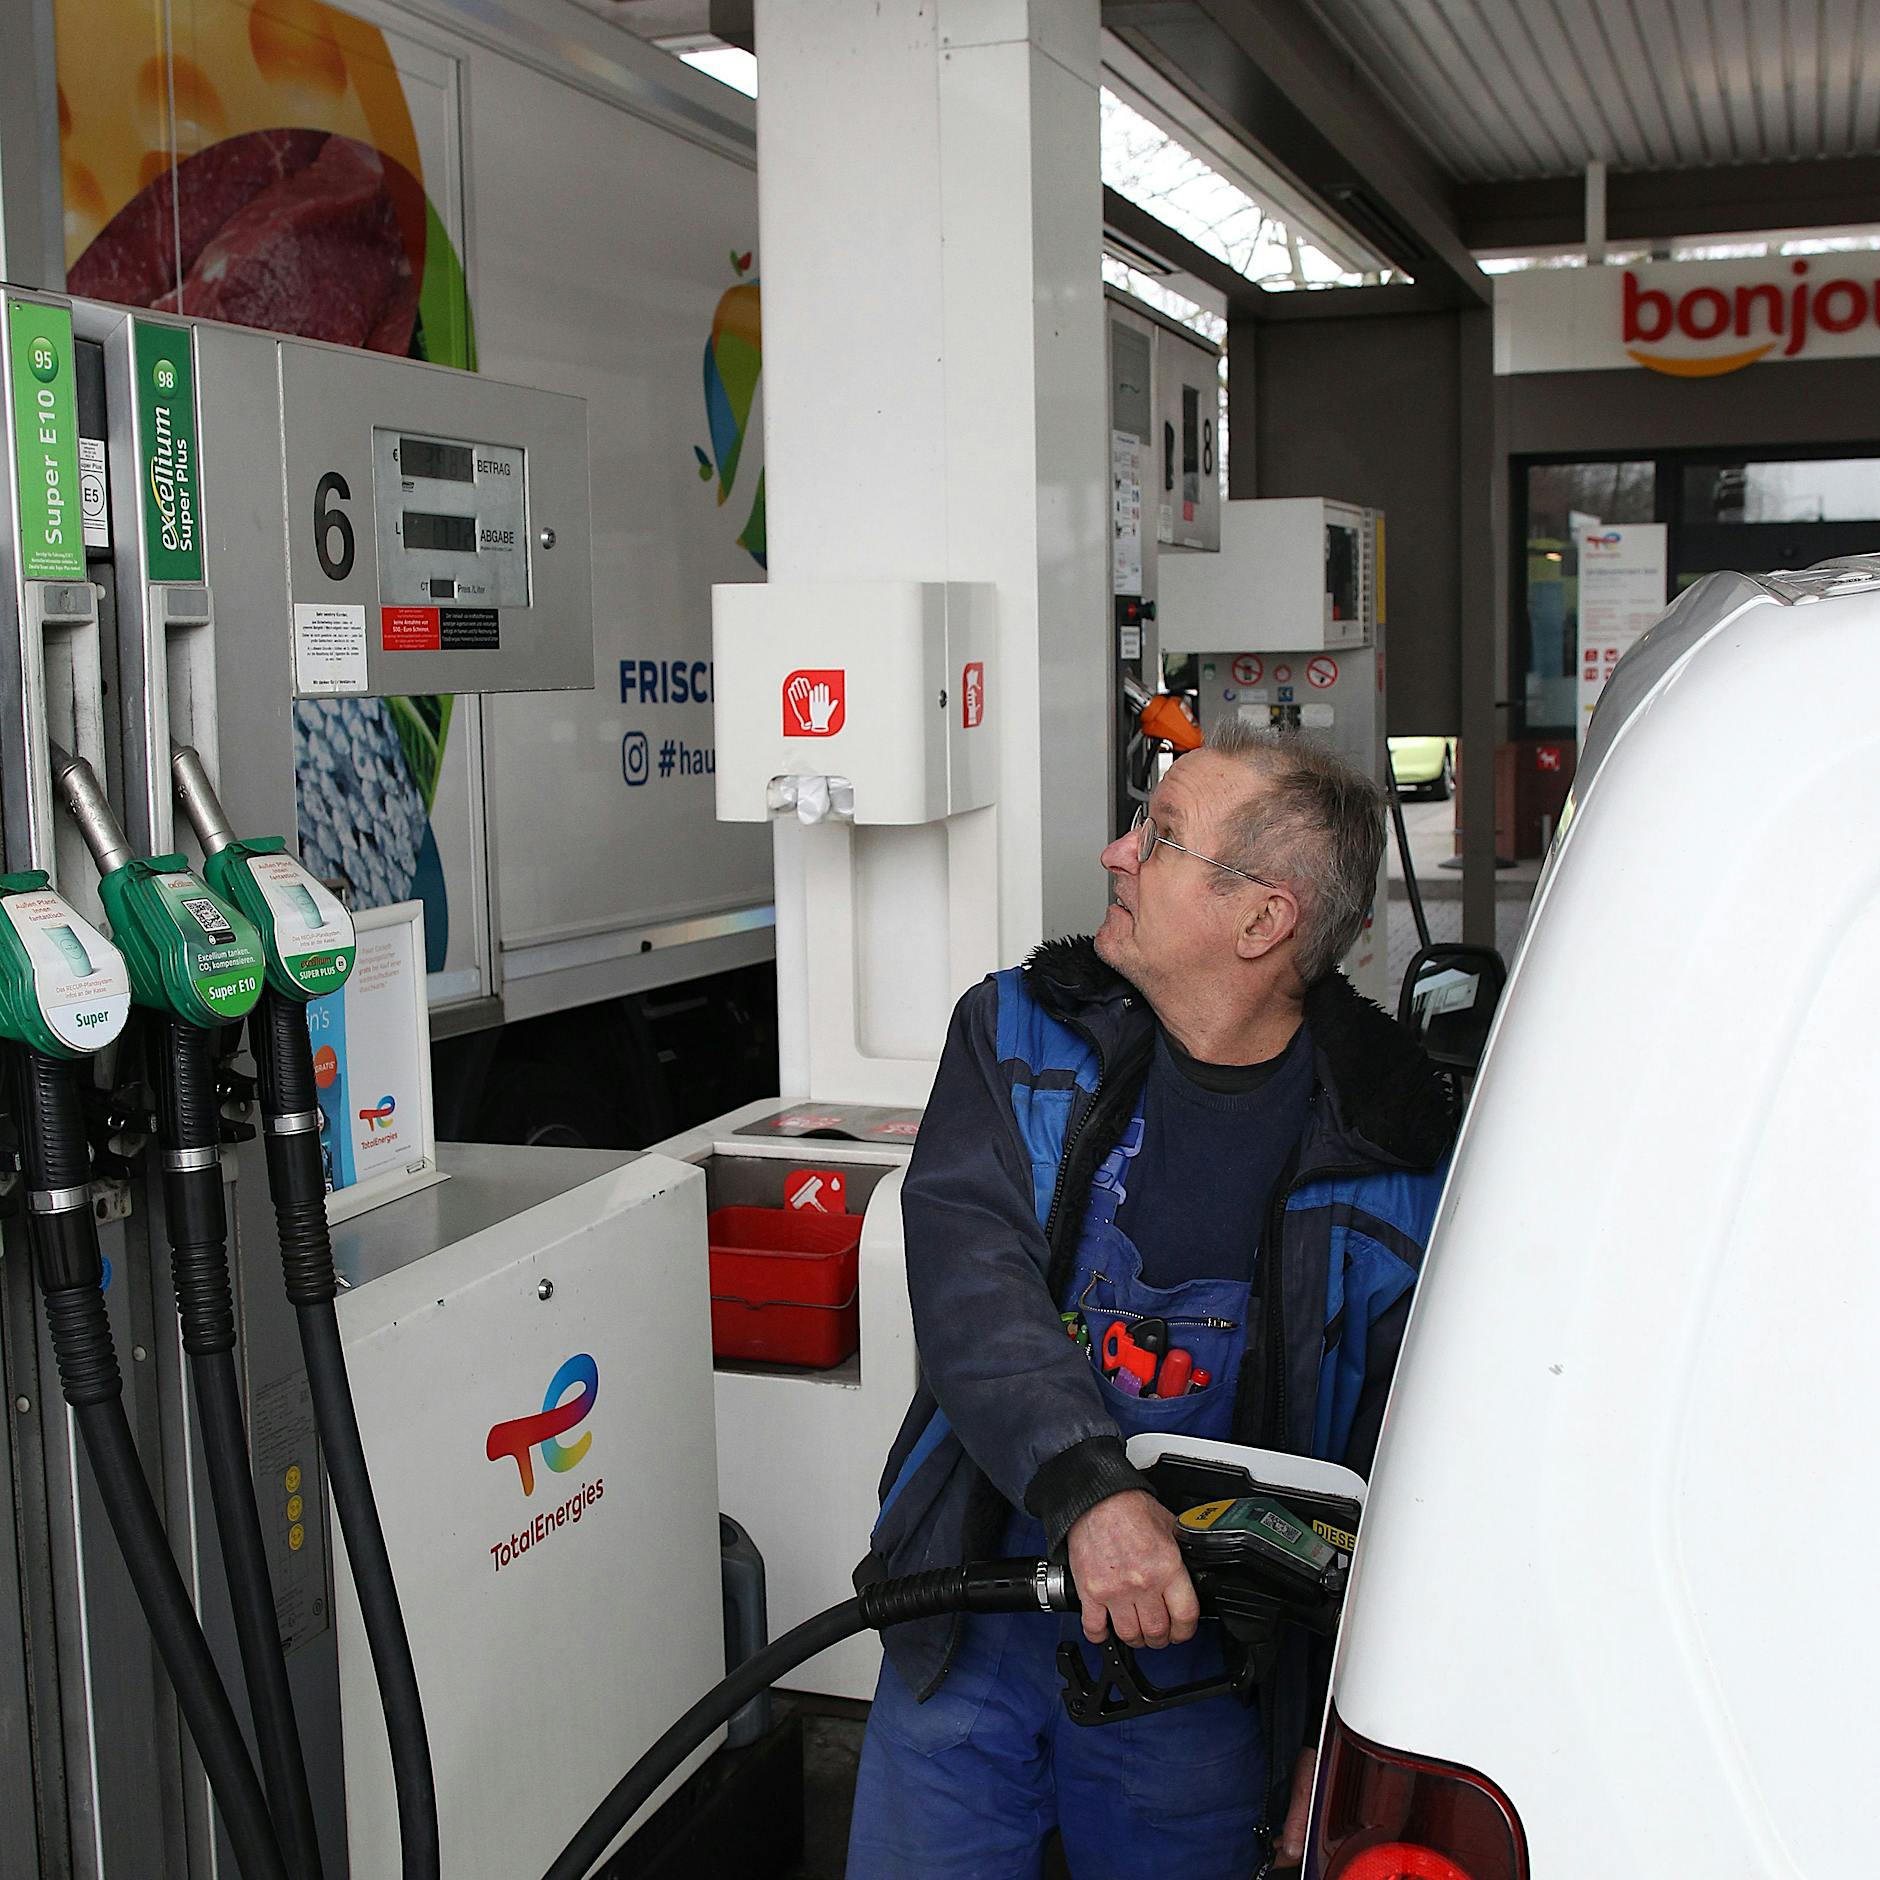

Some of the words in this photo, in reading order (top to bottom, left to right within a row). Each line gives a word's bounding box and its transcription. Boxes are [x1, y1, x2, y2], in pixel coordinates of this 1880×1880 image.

[1623, 259, 1880, 356] bonjo
[34, 349, 53, 370] 95
[157, 370, 174, 389] 98
[36, 389, 57, 445] E10
[1203, 418, 1213, 476] 8
[174, 437, 190, 484] Plus
[477, 459, 511, 476] BETRAG
[151, 406, 178, 552] excellium
[44, 454, 65, 545] Super
[84, 487, 99, 504] E5
[177, 496, 193, 552] Super
[313, 471, 355, 582] 6
[395, 521, 401, 535] L
[480, 529, 515, 545] ABGABE
[658, 740, 715, 778] #hau
[197, 952, 227, 962] Excellium
[228, 947, 250, 957] tanken.
[212, 955, 256, 970] kompensieren.
[299, 969, 320, 981] SUPER
[320, 966, 336, 978] PLUS
[208, 984, 237, 1001] Super
[238, 976, 256, 993] E10
[75, 1010, 110, 1028] Super
[361, 1132, 398, 1151] TotalEnergies
[490, 1478, 605, 1572] TotalEnergies
[1315, 1525, 1356, 1550] DIESE
